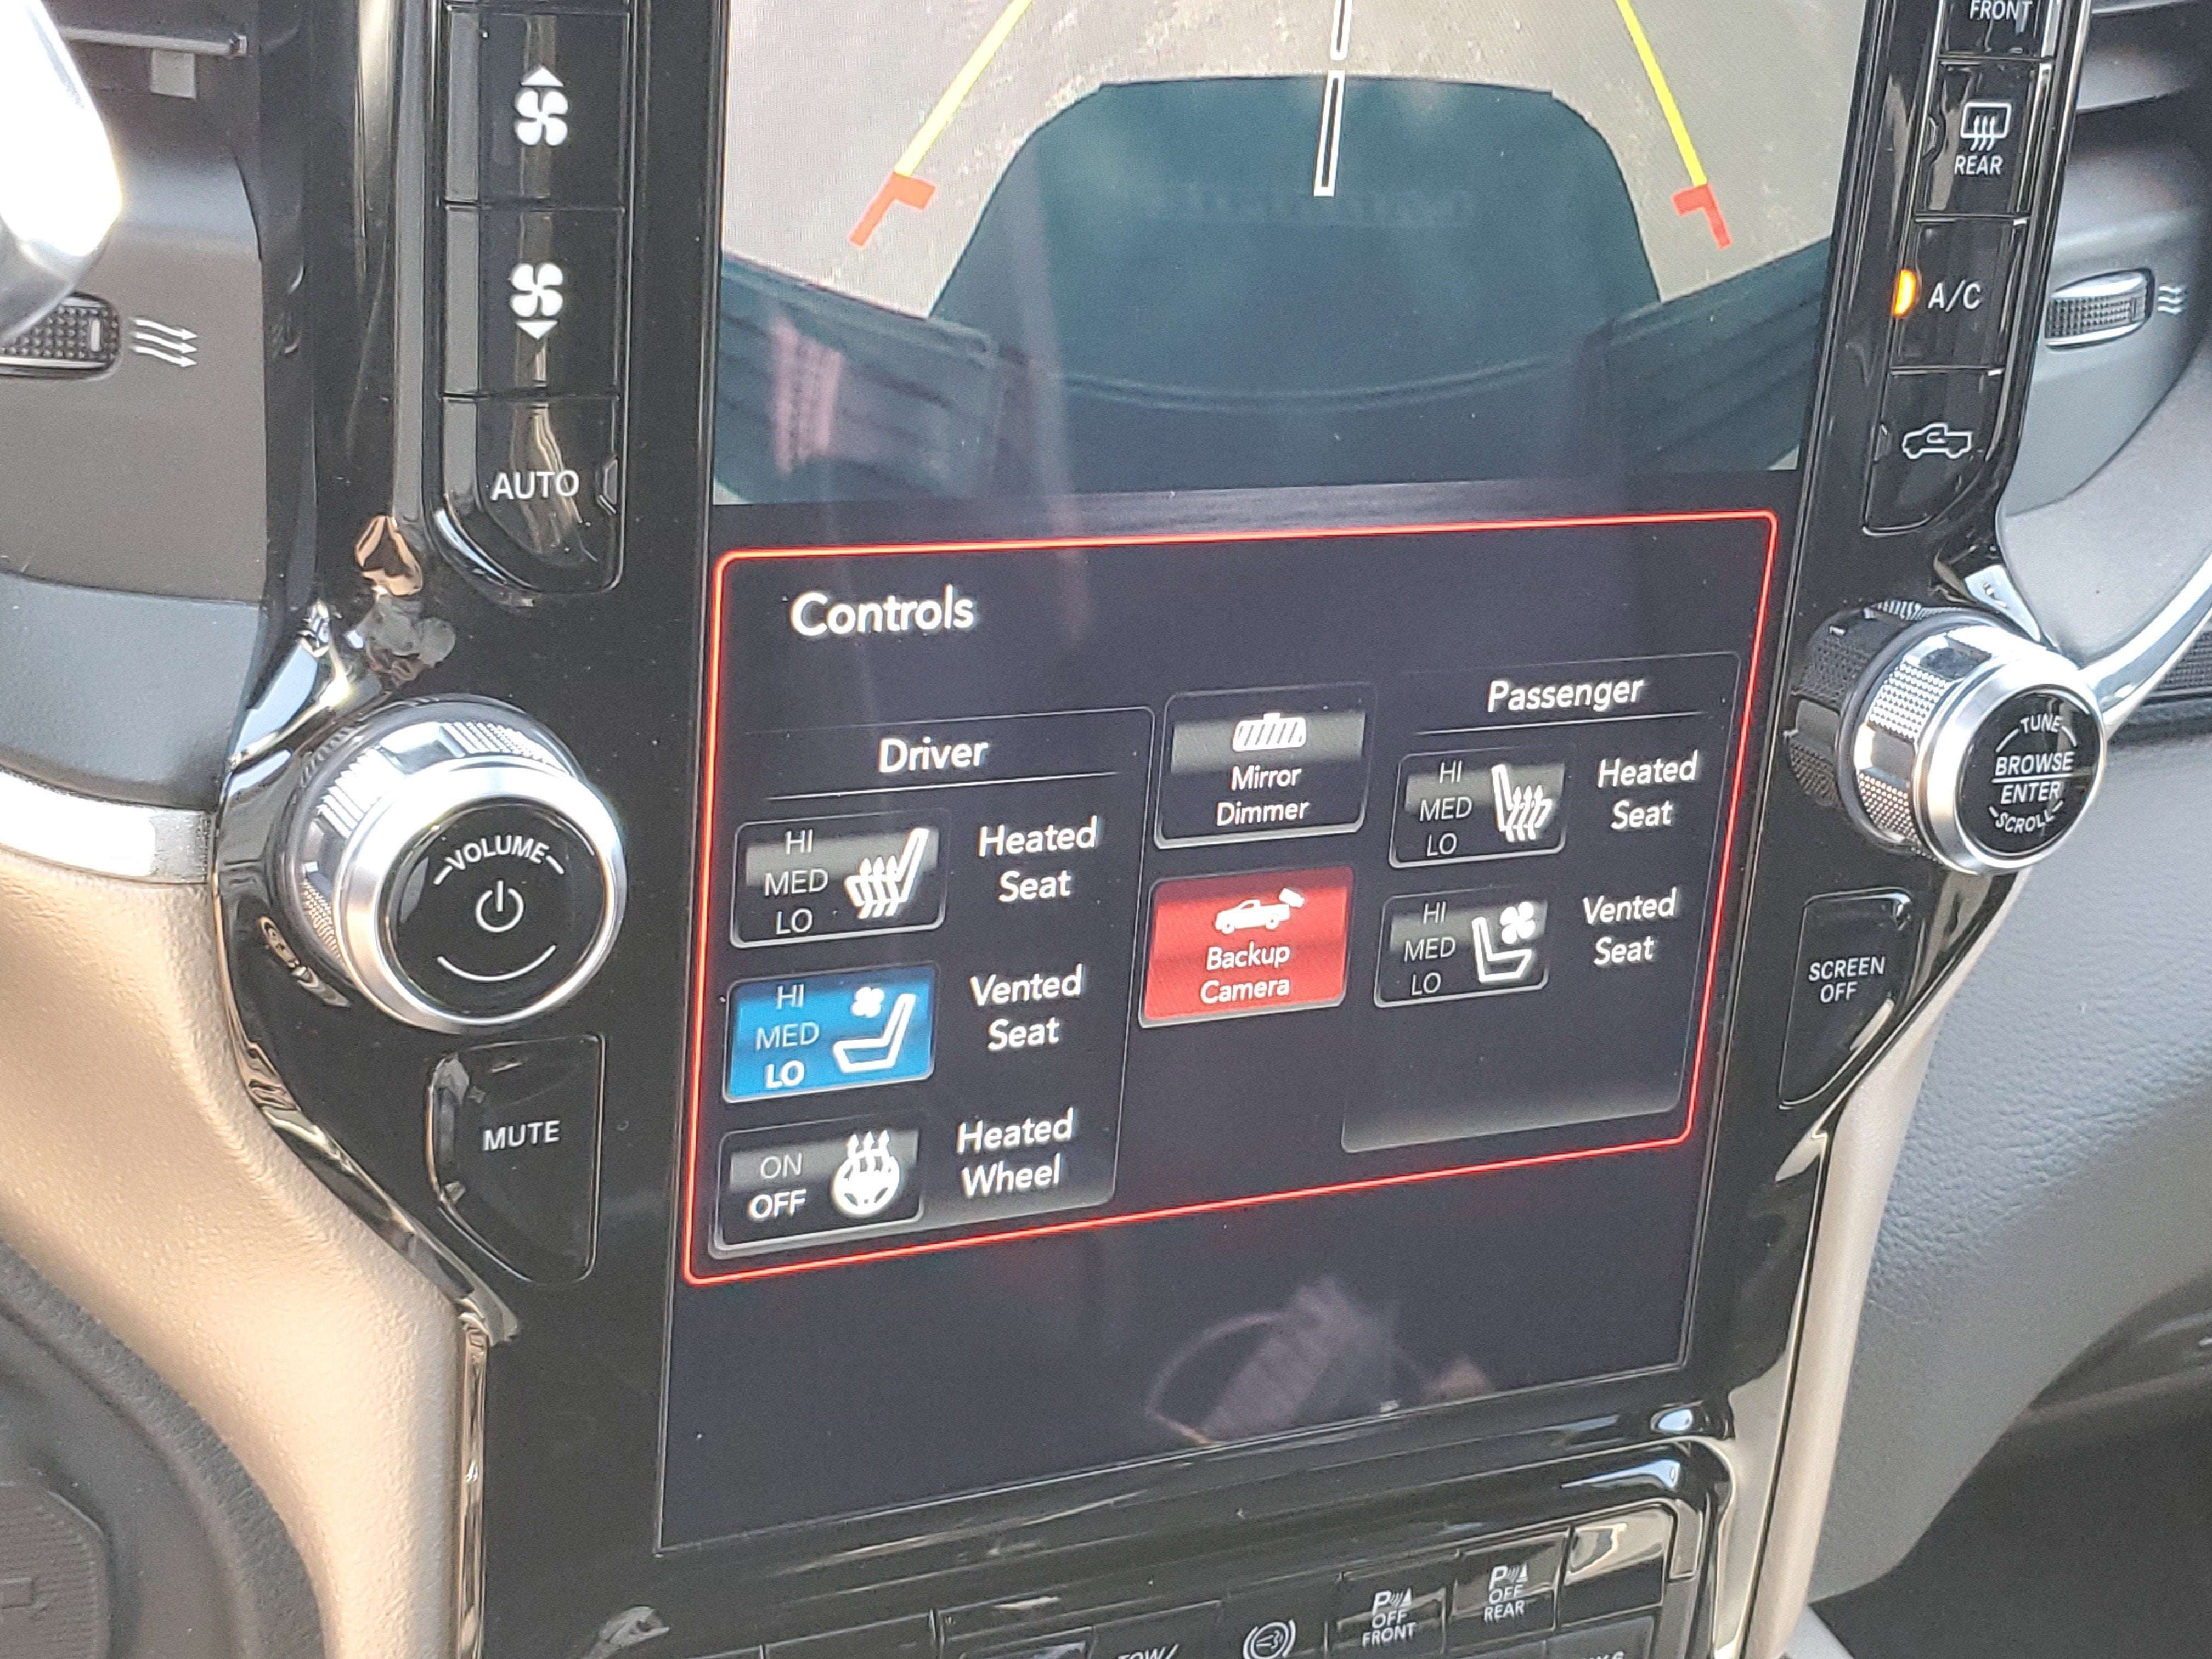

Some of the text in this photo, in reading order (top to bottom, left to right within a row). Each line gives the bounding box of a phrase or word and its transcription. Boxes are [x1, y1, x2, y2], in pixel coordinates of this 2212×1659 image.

[1970, 0, 2033, 21] FRONT
[1954, 155, 2002, 174] REAR
[1928, 280, 1980, 311] A/C
[490, 469, 579, 500] AUTO
[791, 584, 974, 636] Controls
[1488, 680, 1644, 712] Passenger
[2021, 714, 2063, 733] TUNE
[879, 737, 988, 772] Driver
[1995, 751, 2074, 776] BROWSE
[1232, 765, 1301, 790] Mirror
[1439, 761, 1462, 783] HI
[1598, 750, 1697, 787] Heated
[2000, 781, 2061, 805] ENTER
[1217, 802, 1310, 826] Dimmer
[1419, 797, 1472, 821] MED
[1611, 800, 1673, 830] Seat
[1996, 811, 2054, 833] SCROLL
[785, 830, 812, 854] HI
[979, 815, 1097, 856] Heated
[1427, 833, 1457, 856] LO
[445, 835, 549, 871] VOLUME
[764, 868, 829, 896] MED
[999, 871, 1071, 902] Seat
[1423, 902, 1446, 926] HI
[1583, 887, 1677, 924] Vented
[776, 909, 812, 934] LO
[1207, 941, 1290, 970] Backup
[1404, 937, 1455, 961] MED
[1594, 936, 1654, 965] Seat
[1809, 956, 1886, 982] SCREEN
[776, 984, 804, 1009] HI
[971, 964, 1082, 1006] Vented
[1201, 980, 1289, 1003] Camera
[1412, 973, 1441, 995] LO
[1821, 981, 1857, 1002] OFF
[757, 1022, 819, 1049] MED
[988, 1017, 1060, 1050] Seat
[766, 1060, 804, 1088] LO
[484, 1121, 559, 1150] MUTE
[957, 1107, 1073, 1154] Heated
[760, 1153, 802, 1178] ON
[962, 1153, 1060, 1197] Wheel
[749, 1189, 806, 1219] OFF
[1489, 1584, 1523, 1604] OFF
[1372, 1609, 1408, 1629] OFF
[1484, 1601, 1525, 1621] REAR
[1363, 1622, 1416, 1646] FRONT
